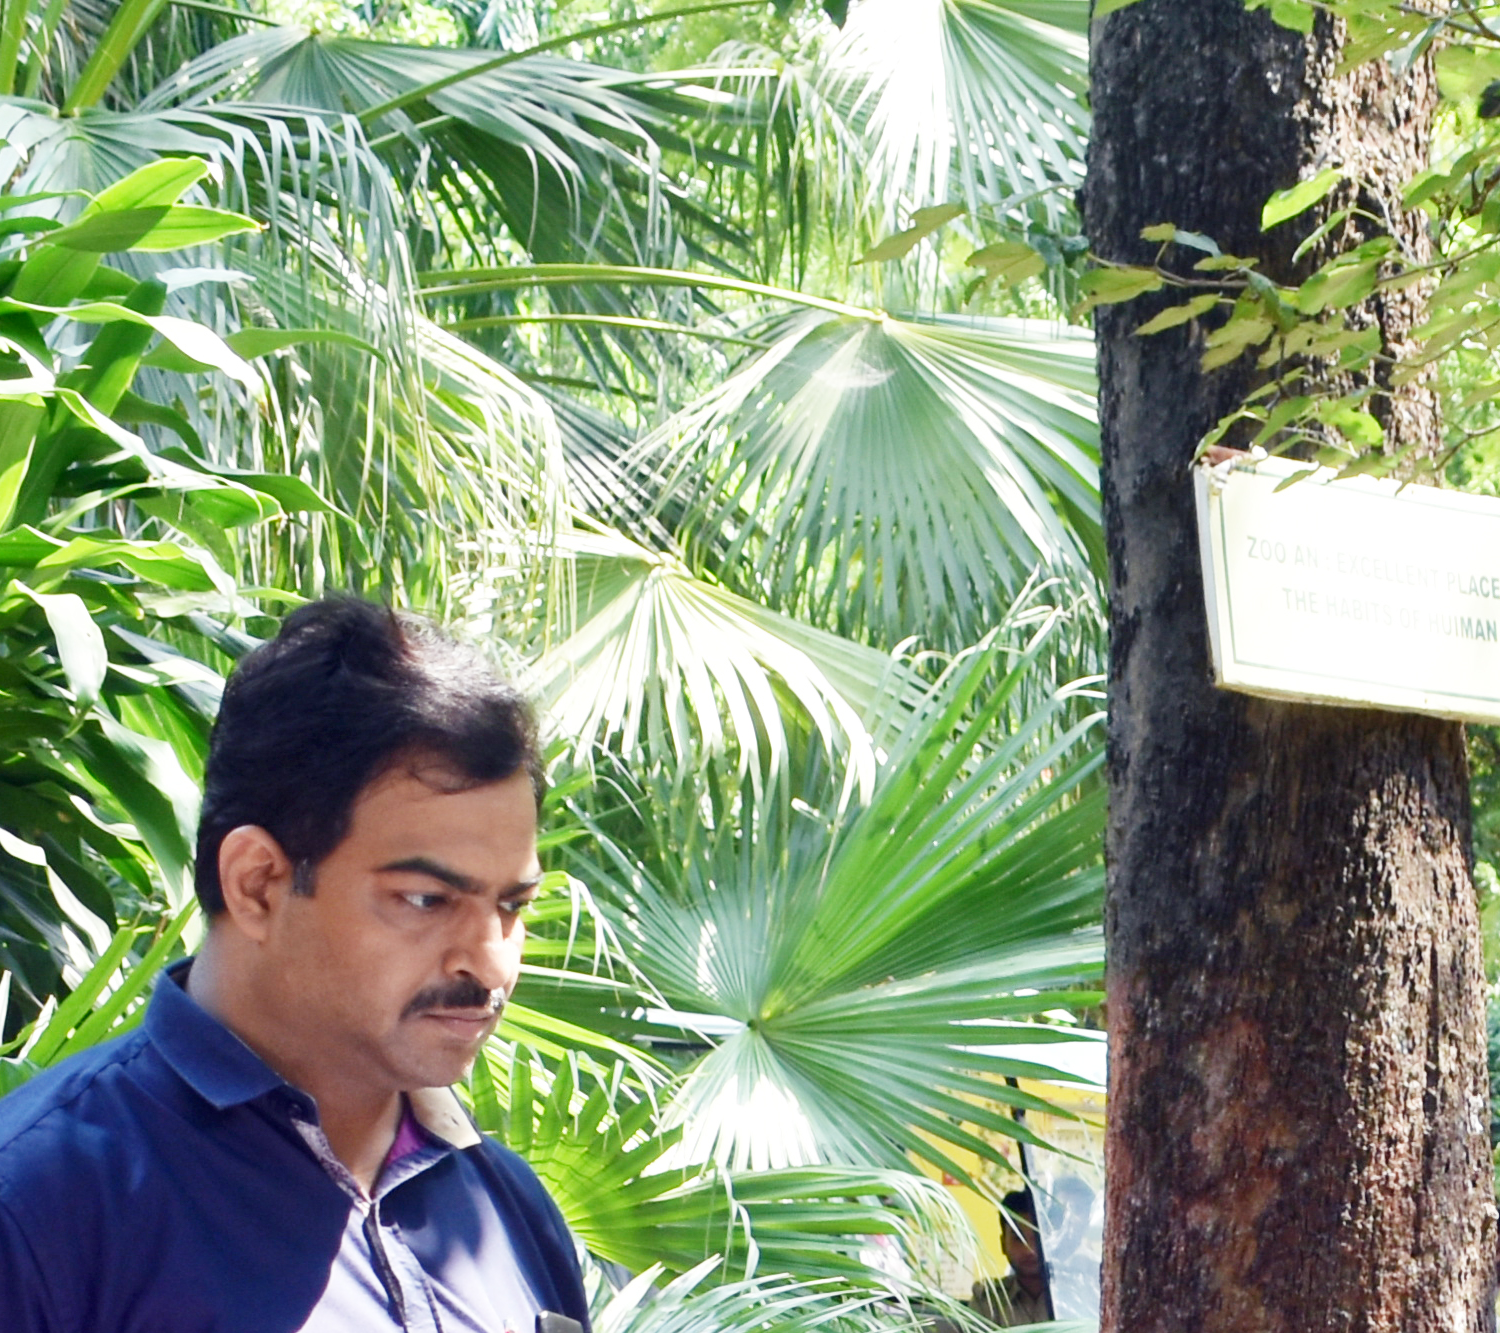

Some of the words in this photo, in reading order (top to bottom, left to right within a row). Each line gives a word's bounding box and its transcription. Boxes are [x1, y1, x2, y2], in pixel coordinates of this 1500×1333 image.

[1246, 535, 1286, 564] ZOO
[1294, 544, 1319, 569] AN
[1337, 551, 1438, 590] EXCELLENT
[1447, 571, 1500, 600] PLACE
[1281, 586, 1320, 614] THE
[1325, 593, 1392, 626] HABITS
[1399, 607, 1420, 629] OF
